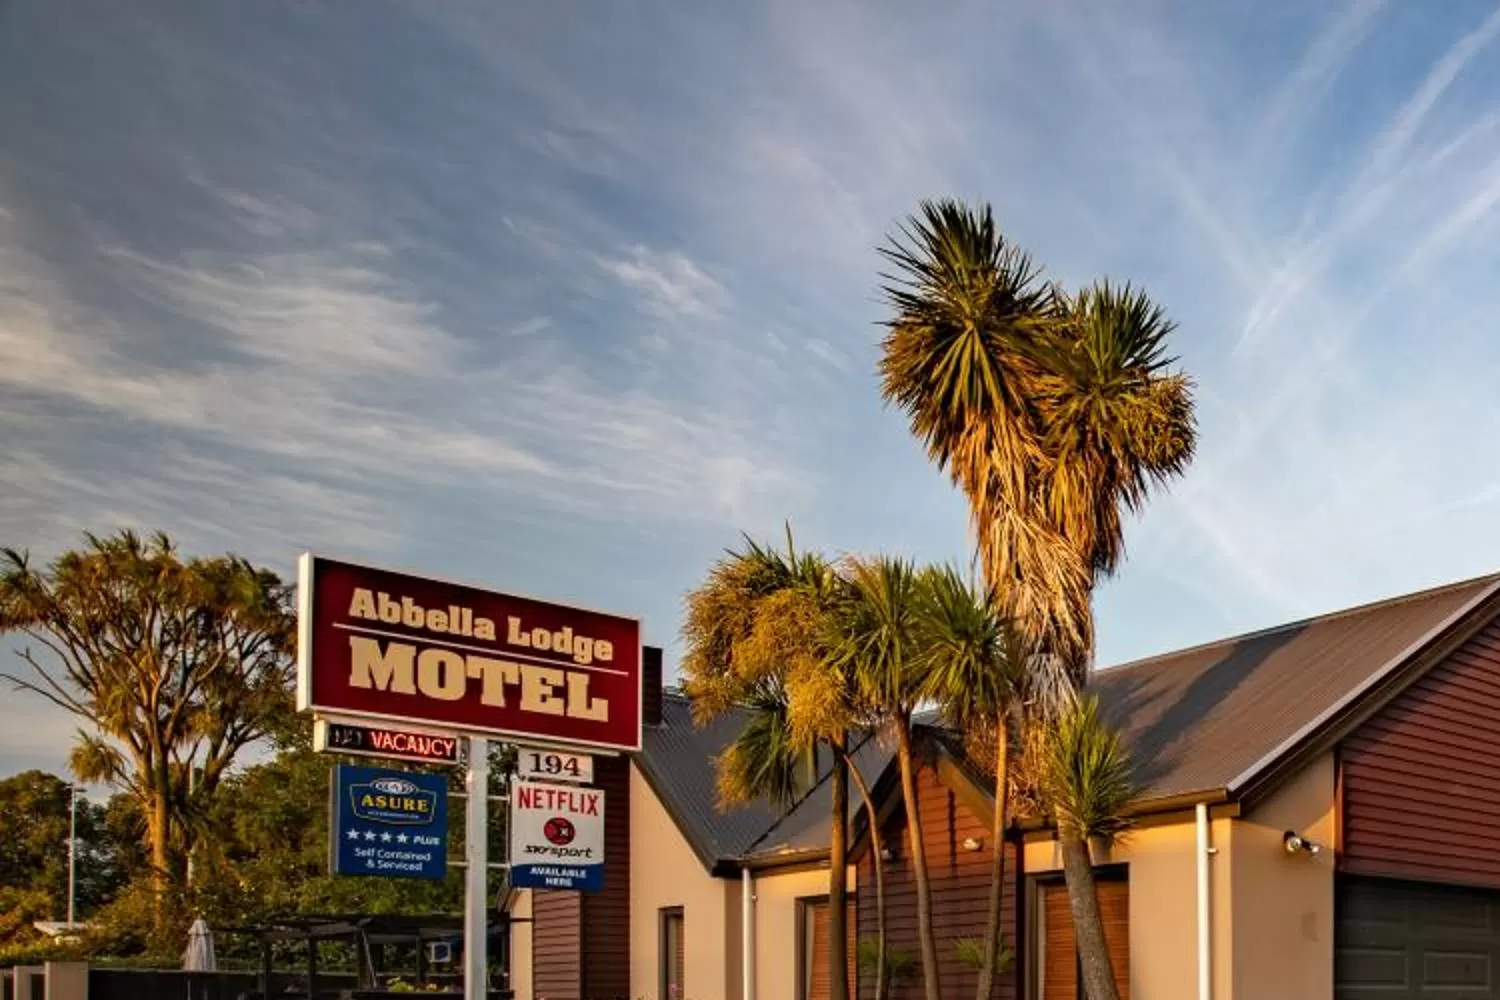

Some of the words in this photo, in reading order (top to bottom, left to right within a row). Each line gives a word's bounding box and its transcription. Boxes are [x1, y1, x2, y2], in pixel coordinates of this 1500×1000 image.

[349, 587, 496, 641] Abbella
[507, 615, 613, 664] Lodge
[349, 635, 609, 722] MOTEL
[370, 731, 454, 757] VACANCY
[529, 753, 581, 777] 194
[361, 794, 429, 812] ASURE
[518, 786, 598, 816] NETFLIX
[413, 835, 440, 845] PLUS
[354, 847, 375, 857] Self
[377, 849, 431, 862] Contained
[377, 860, 423, 871] Serviced
[530, 866, 587, 879] AVAILABLE
